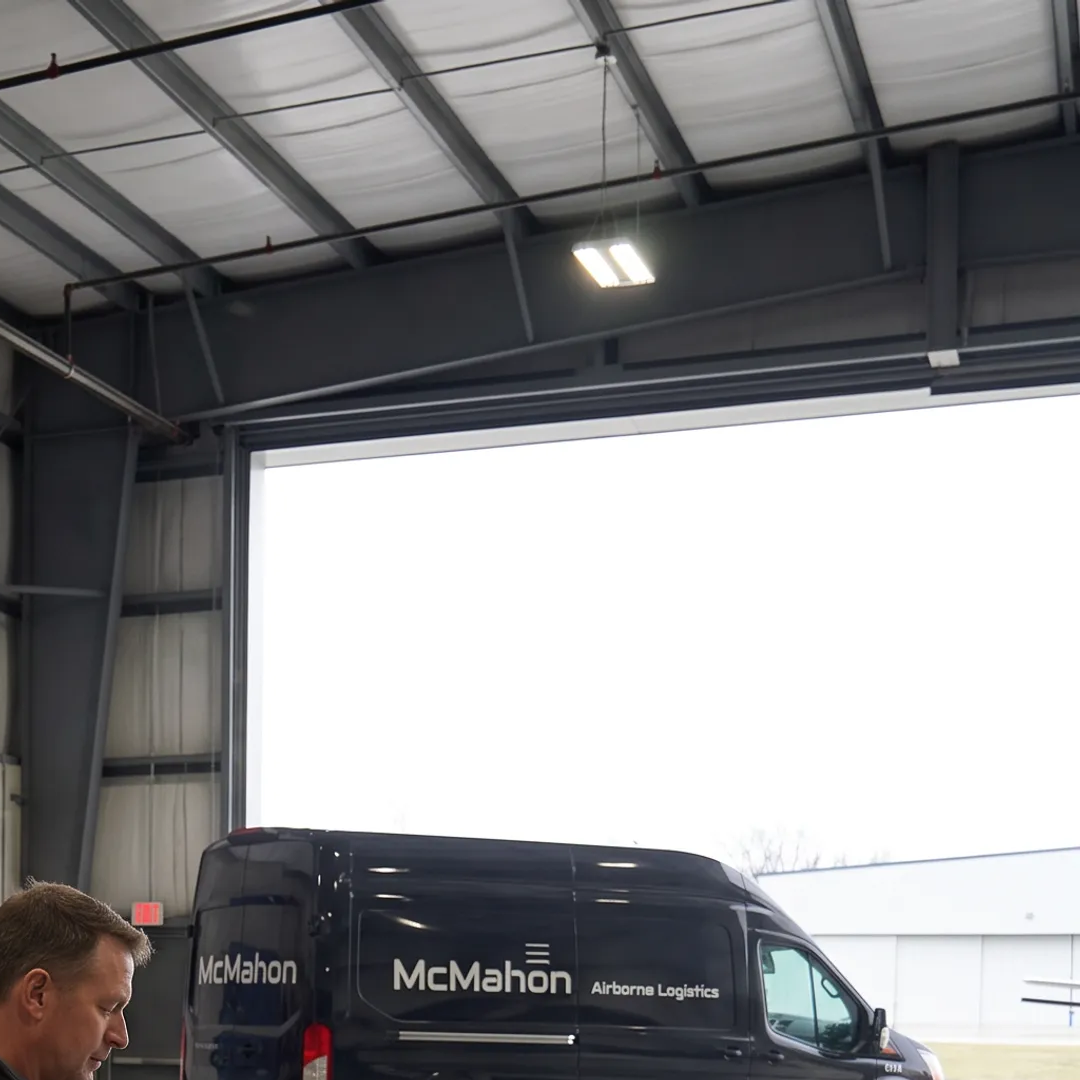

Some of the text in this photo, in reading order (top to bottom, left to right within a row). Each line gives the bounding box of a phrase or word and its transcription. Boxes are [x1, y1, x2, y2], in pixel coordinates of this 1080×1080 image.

[198, 951, 298, 985] McMahon
[393, 958, 572, 994] McMahon
[591, 981, 720, 1001] Airborne Logistics
